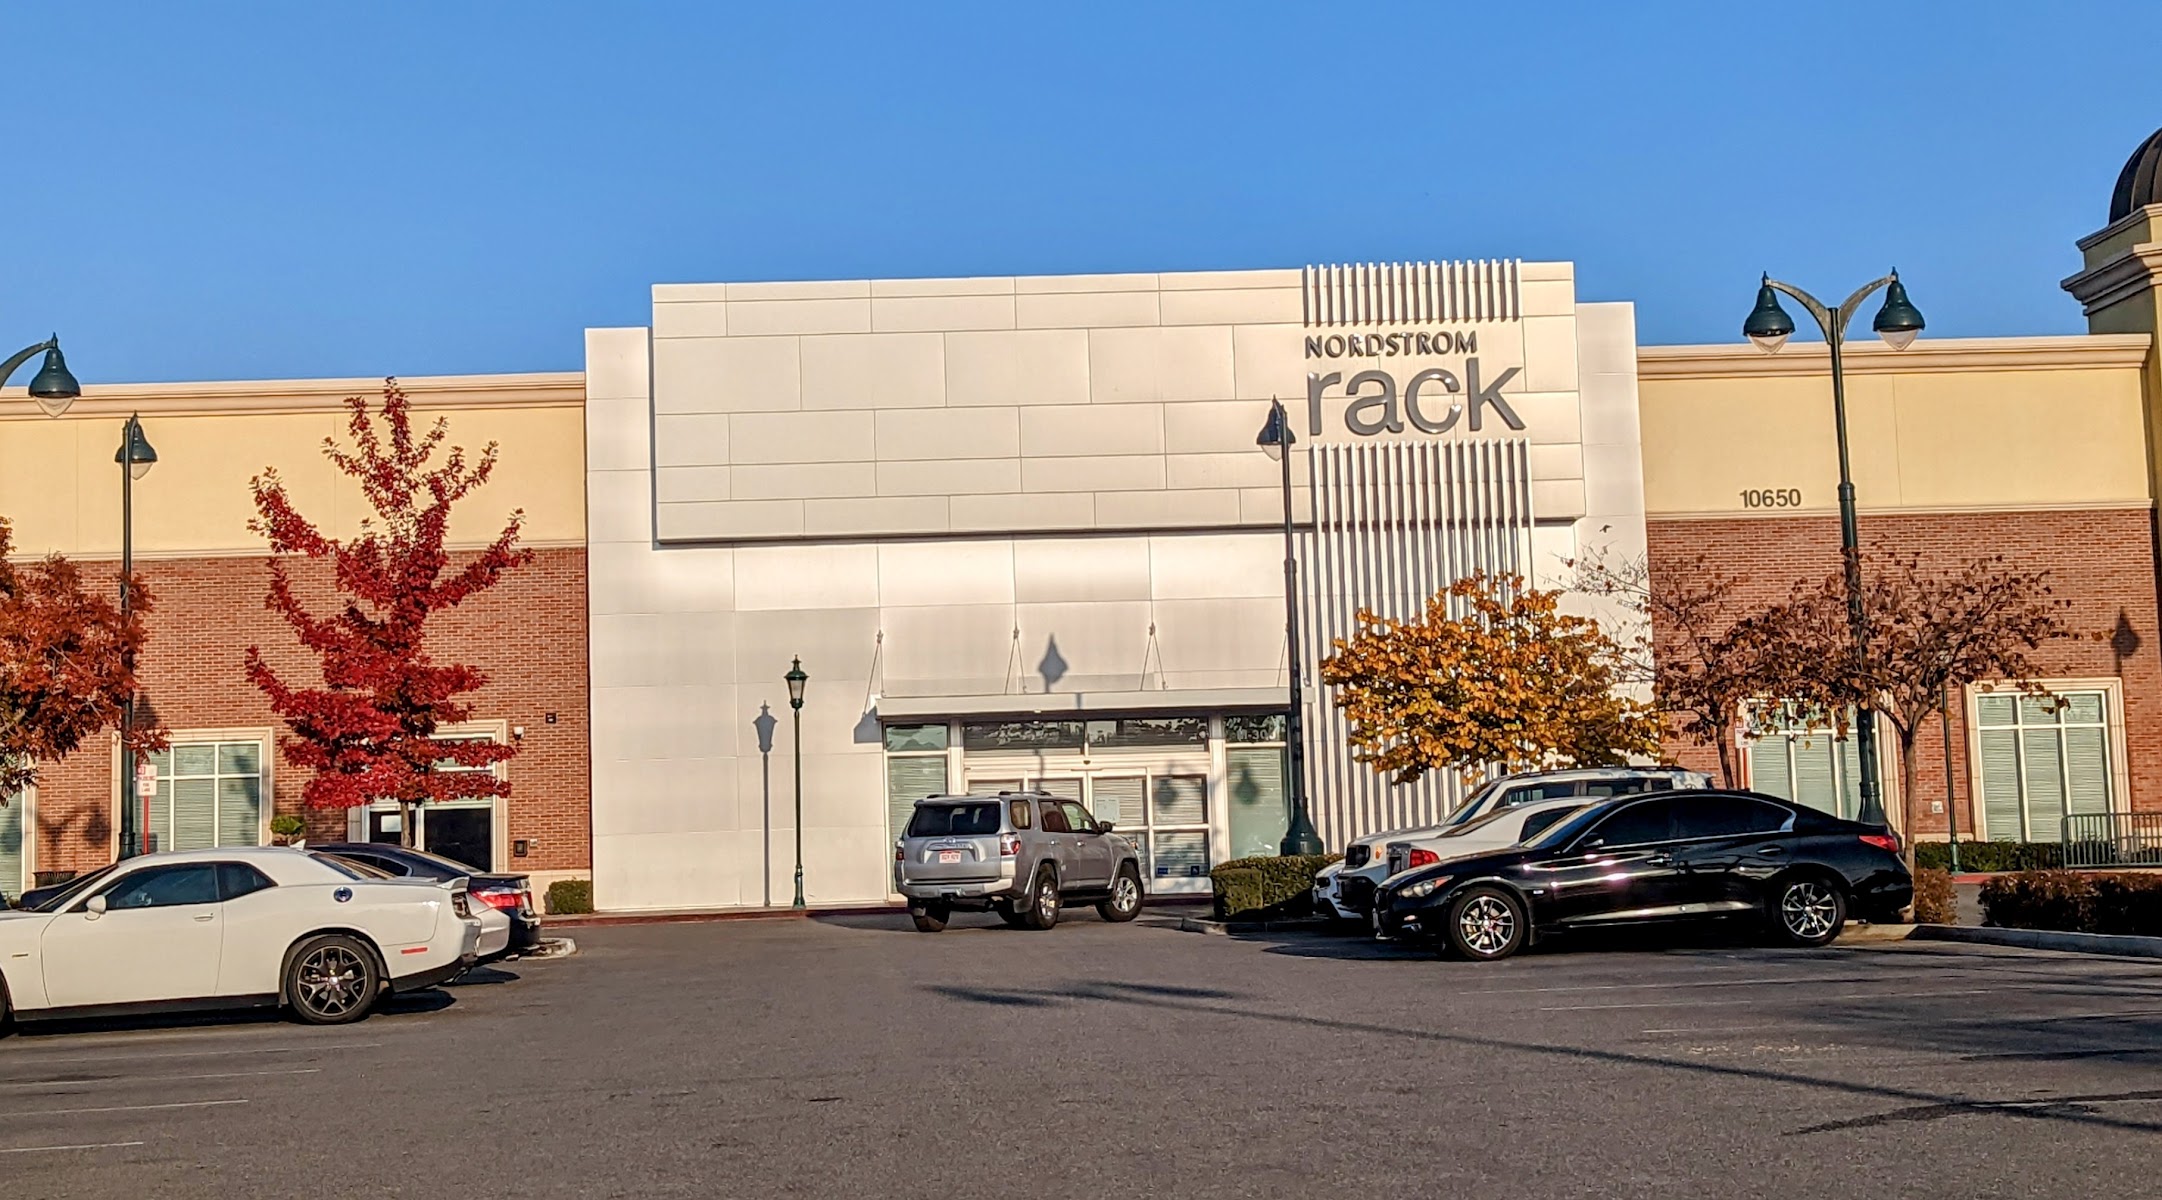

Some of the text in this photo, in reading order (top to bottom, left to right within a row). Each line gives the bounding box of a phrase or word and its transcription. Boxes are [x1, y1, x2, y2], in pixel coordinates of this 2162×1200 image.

[1305, 330, 1478, 359] NORDSTROM
[1307, 357, 1527, 437] rack
[1739, 488, 1802, 508] 10650
